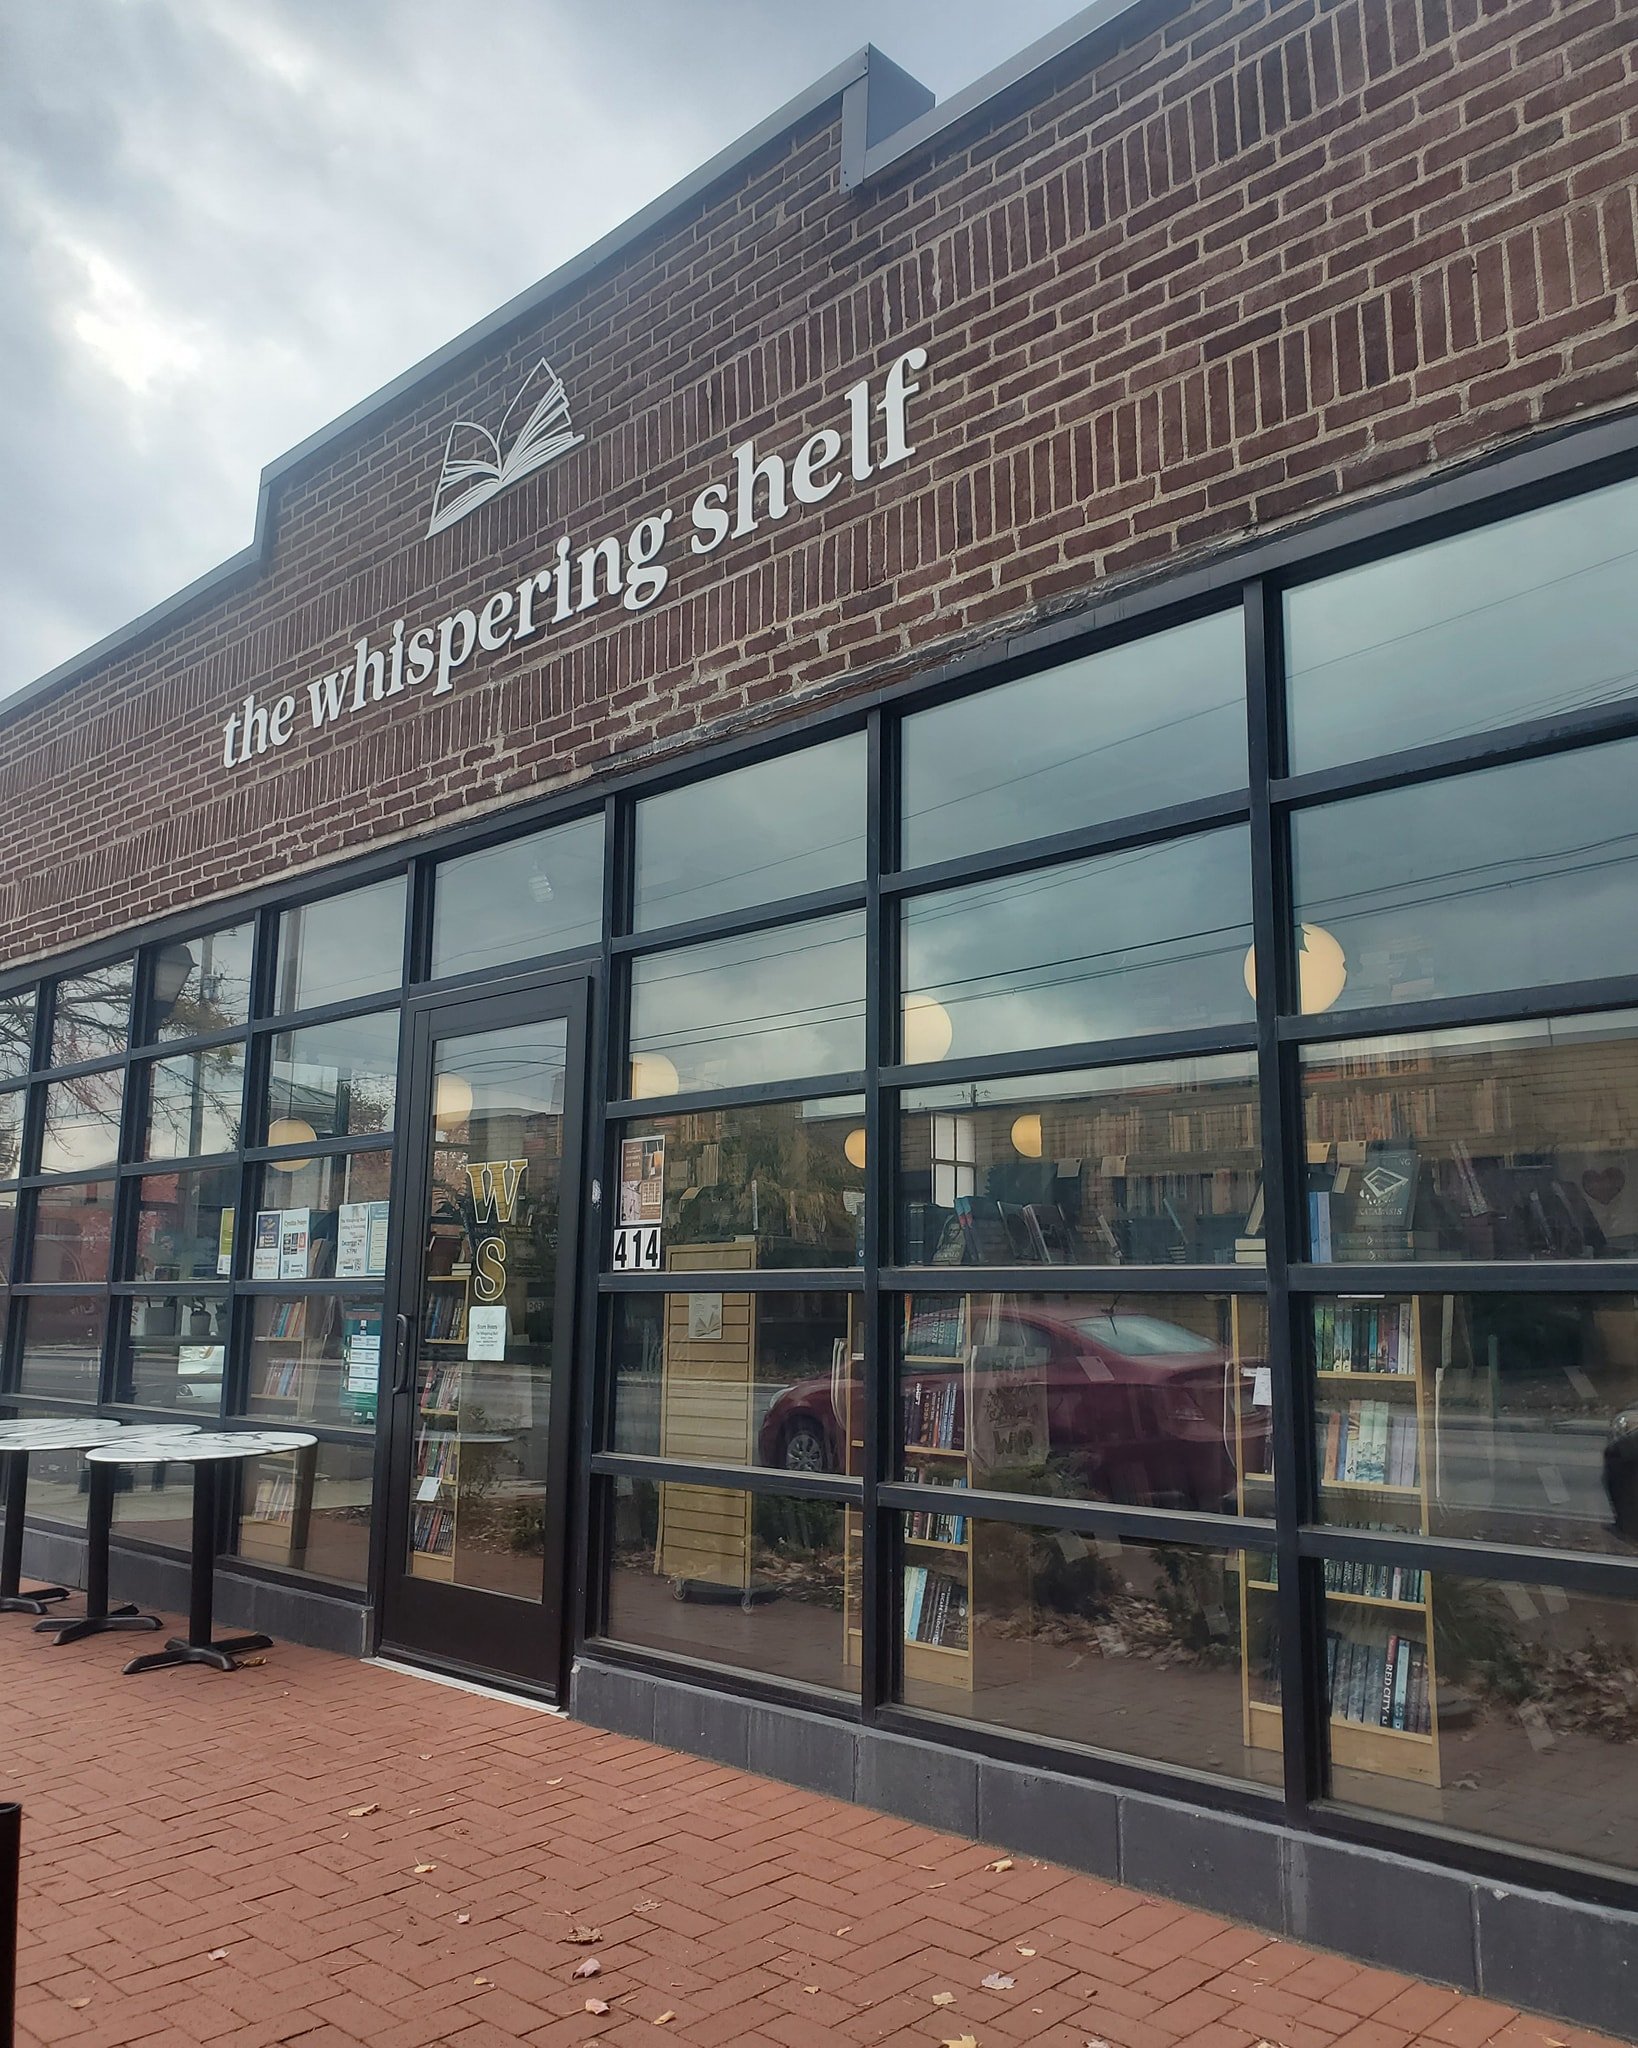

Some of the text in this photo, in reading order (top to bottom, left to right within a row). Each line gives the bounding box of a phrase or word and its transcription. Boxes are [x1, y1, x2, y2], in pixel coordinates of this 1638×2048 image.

[222, 347, 928, 769] the whispering shelf
[466, 1158, 528, 1224] W
[474, 1236, 507, 1302] S
[614, 1229, 658, 1269] 414
[1381, 1663, 1394, 1713] RED CITY
